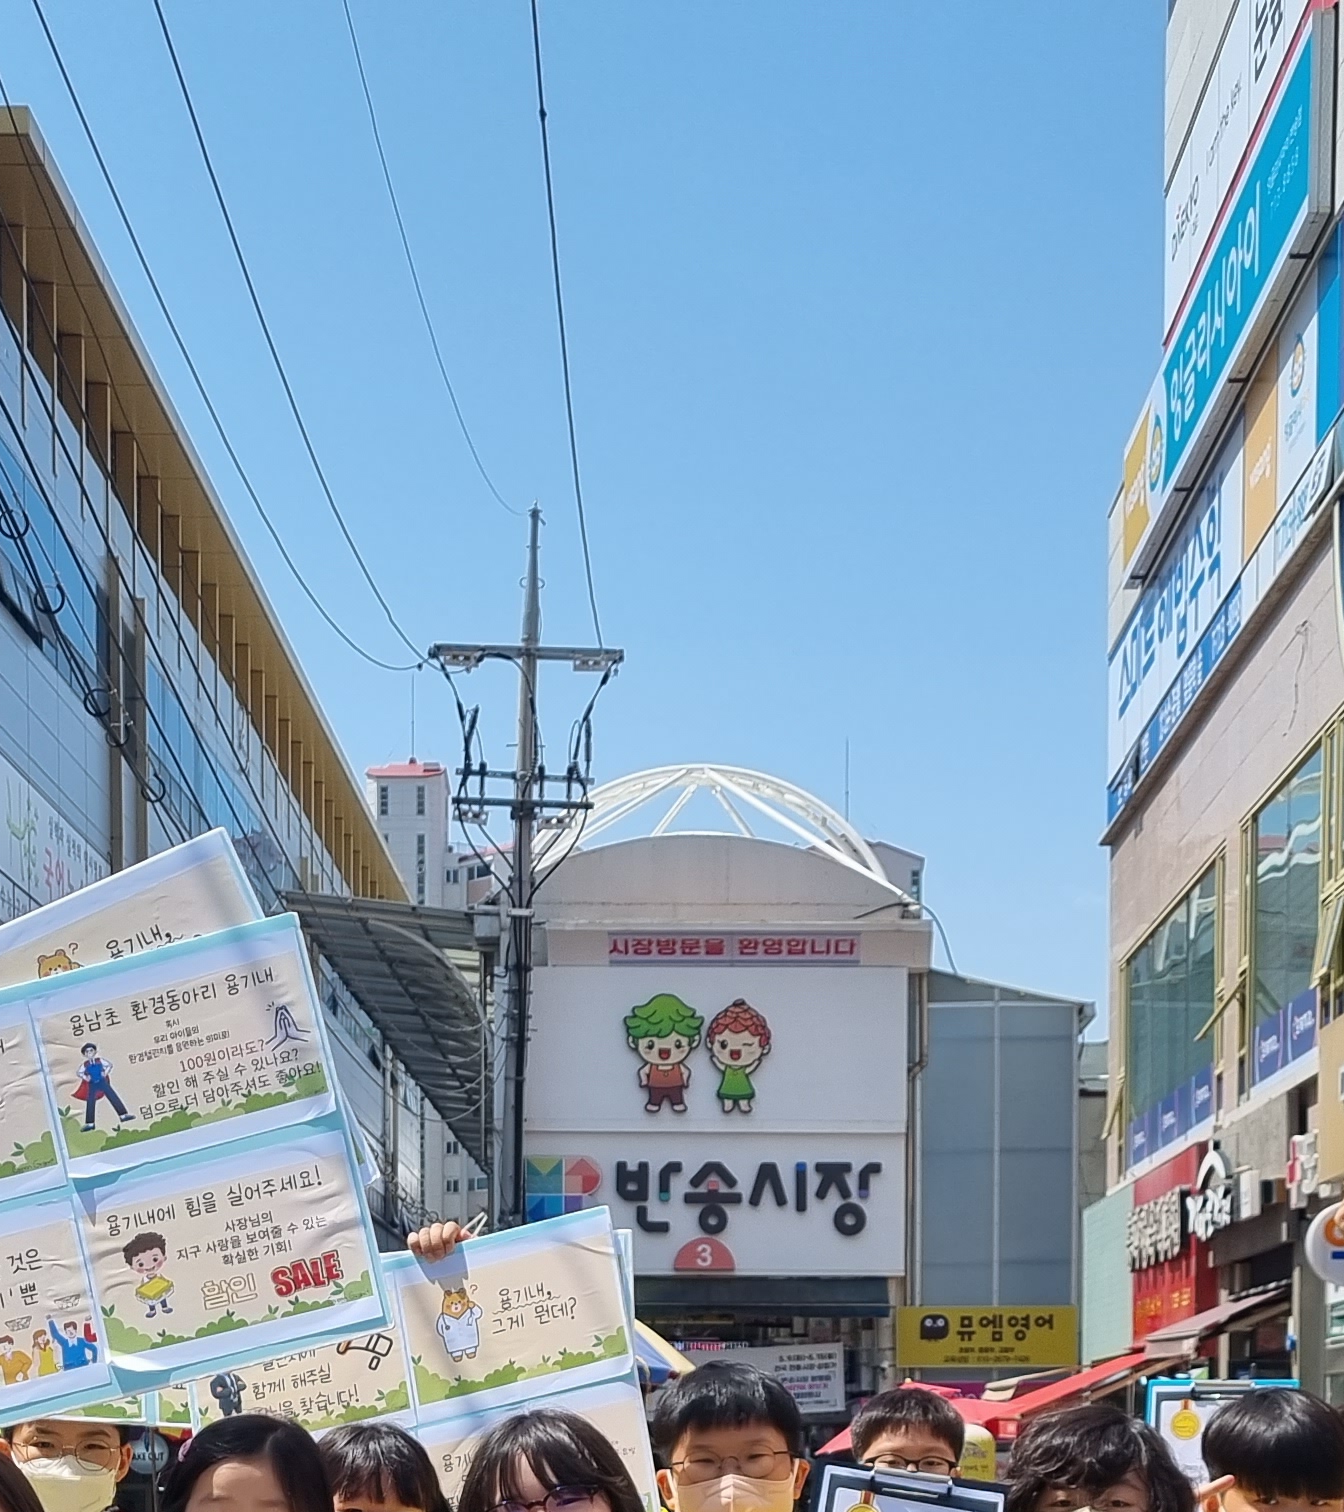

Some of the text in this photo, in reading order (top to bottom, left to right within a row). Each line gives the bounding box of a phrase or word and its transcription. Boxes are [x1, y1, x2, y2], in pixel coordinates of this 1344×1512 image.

[1168, 182, 1262, 443] 잉글리시아이
[608, 936, 858, 957] 시장방문을 환영합니다
[69, 966, 275, 1037] 용남초 환경동아리 용기내
[179, 1039, 265, 1073] 100원이라도?
[203, 1048, 300, 1088] 주실 있나요?
[202, 1075, 271, 1105] 담아주셔도
[106, 1164, 323, 1237] 용기내에 힘을 실어주세요!
[616, 1160, 883, 1237] 반송시장
[176, 1216, 328, 1261] 지구 있는
[224, 1211, 274, 1233] 사장님의
[6, 1248, 43, 1275] 것은
[222, 1249, 260, 1266] 확실한
[696, 1244, 713, 1267] 3
[271, 1249, 344, 1297] SALE
[20, 1282, 39, 1306] 뿐
[201, 1272, 258, 1311] 할인
[492, 1296, 577, 1334] 그게 뭔데?
[956, 1313, 1055, 1342] 뮤엠영어
[291, 1363, 332, 1391] 해주실
[299, 1383, 360, 1415] 찾습니다!
